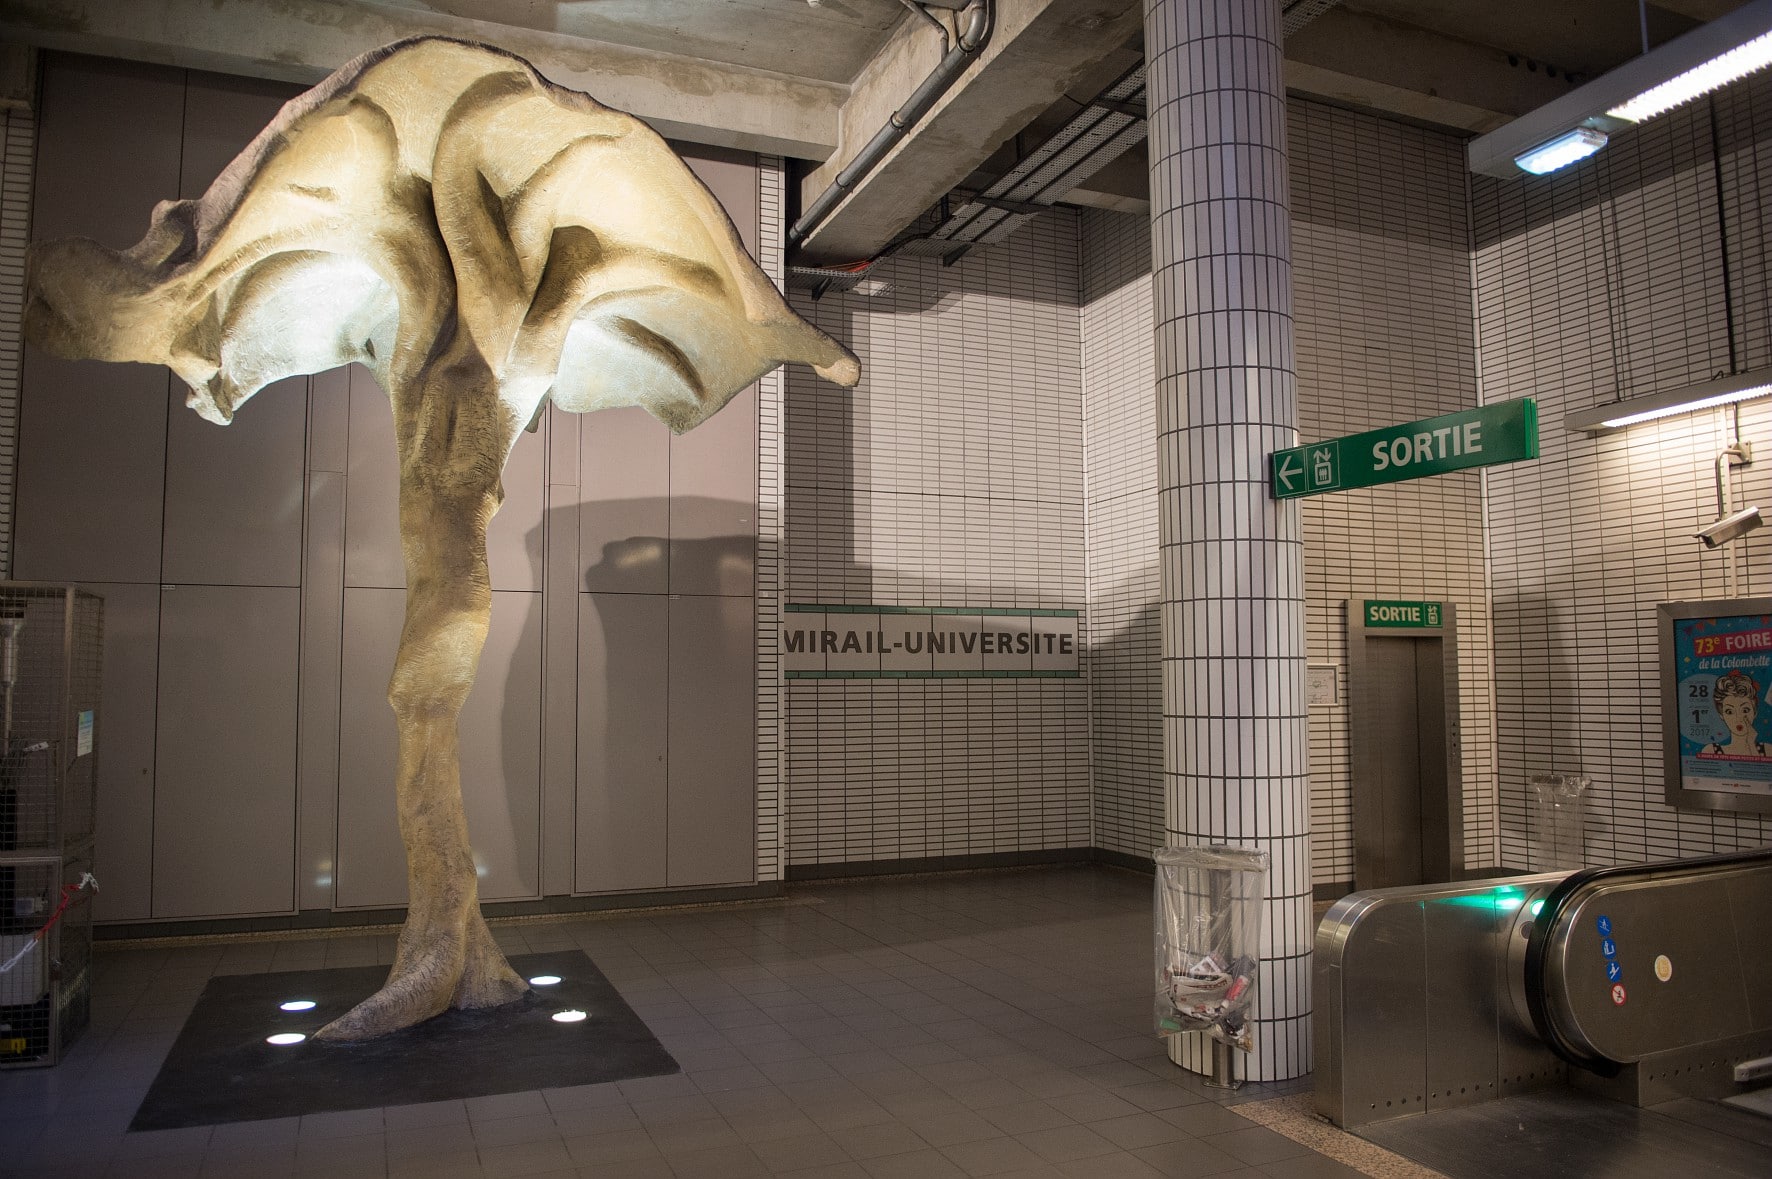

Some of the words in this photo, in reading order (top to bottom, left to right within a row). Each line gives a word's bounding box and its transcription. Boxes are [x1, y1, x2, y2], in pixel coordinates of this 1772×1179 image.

[1372, 420, 1483, 471] SORTIE
[1369, 606, 1421, 622] SORTIE
[784, 629, 1073, 655] MIRAIL-UNIVERSITE
[1695, 636, 1720, 654] 73e
[1725, 632, 1772, 650] FOIRE
[1699, 658, 1709, 670] de
[1711, 657, 1720, 669] la
[1689, 684, 1709, 698] 28
[1691, 709, 1709, 723] 1er
[1689, 728, 1710, 736] 2017
